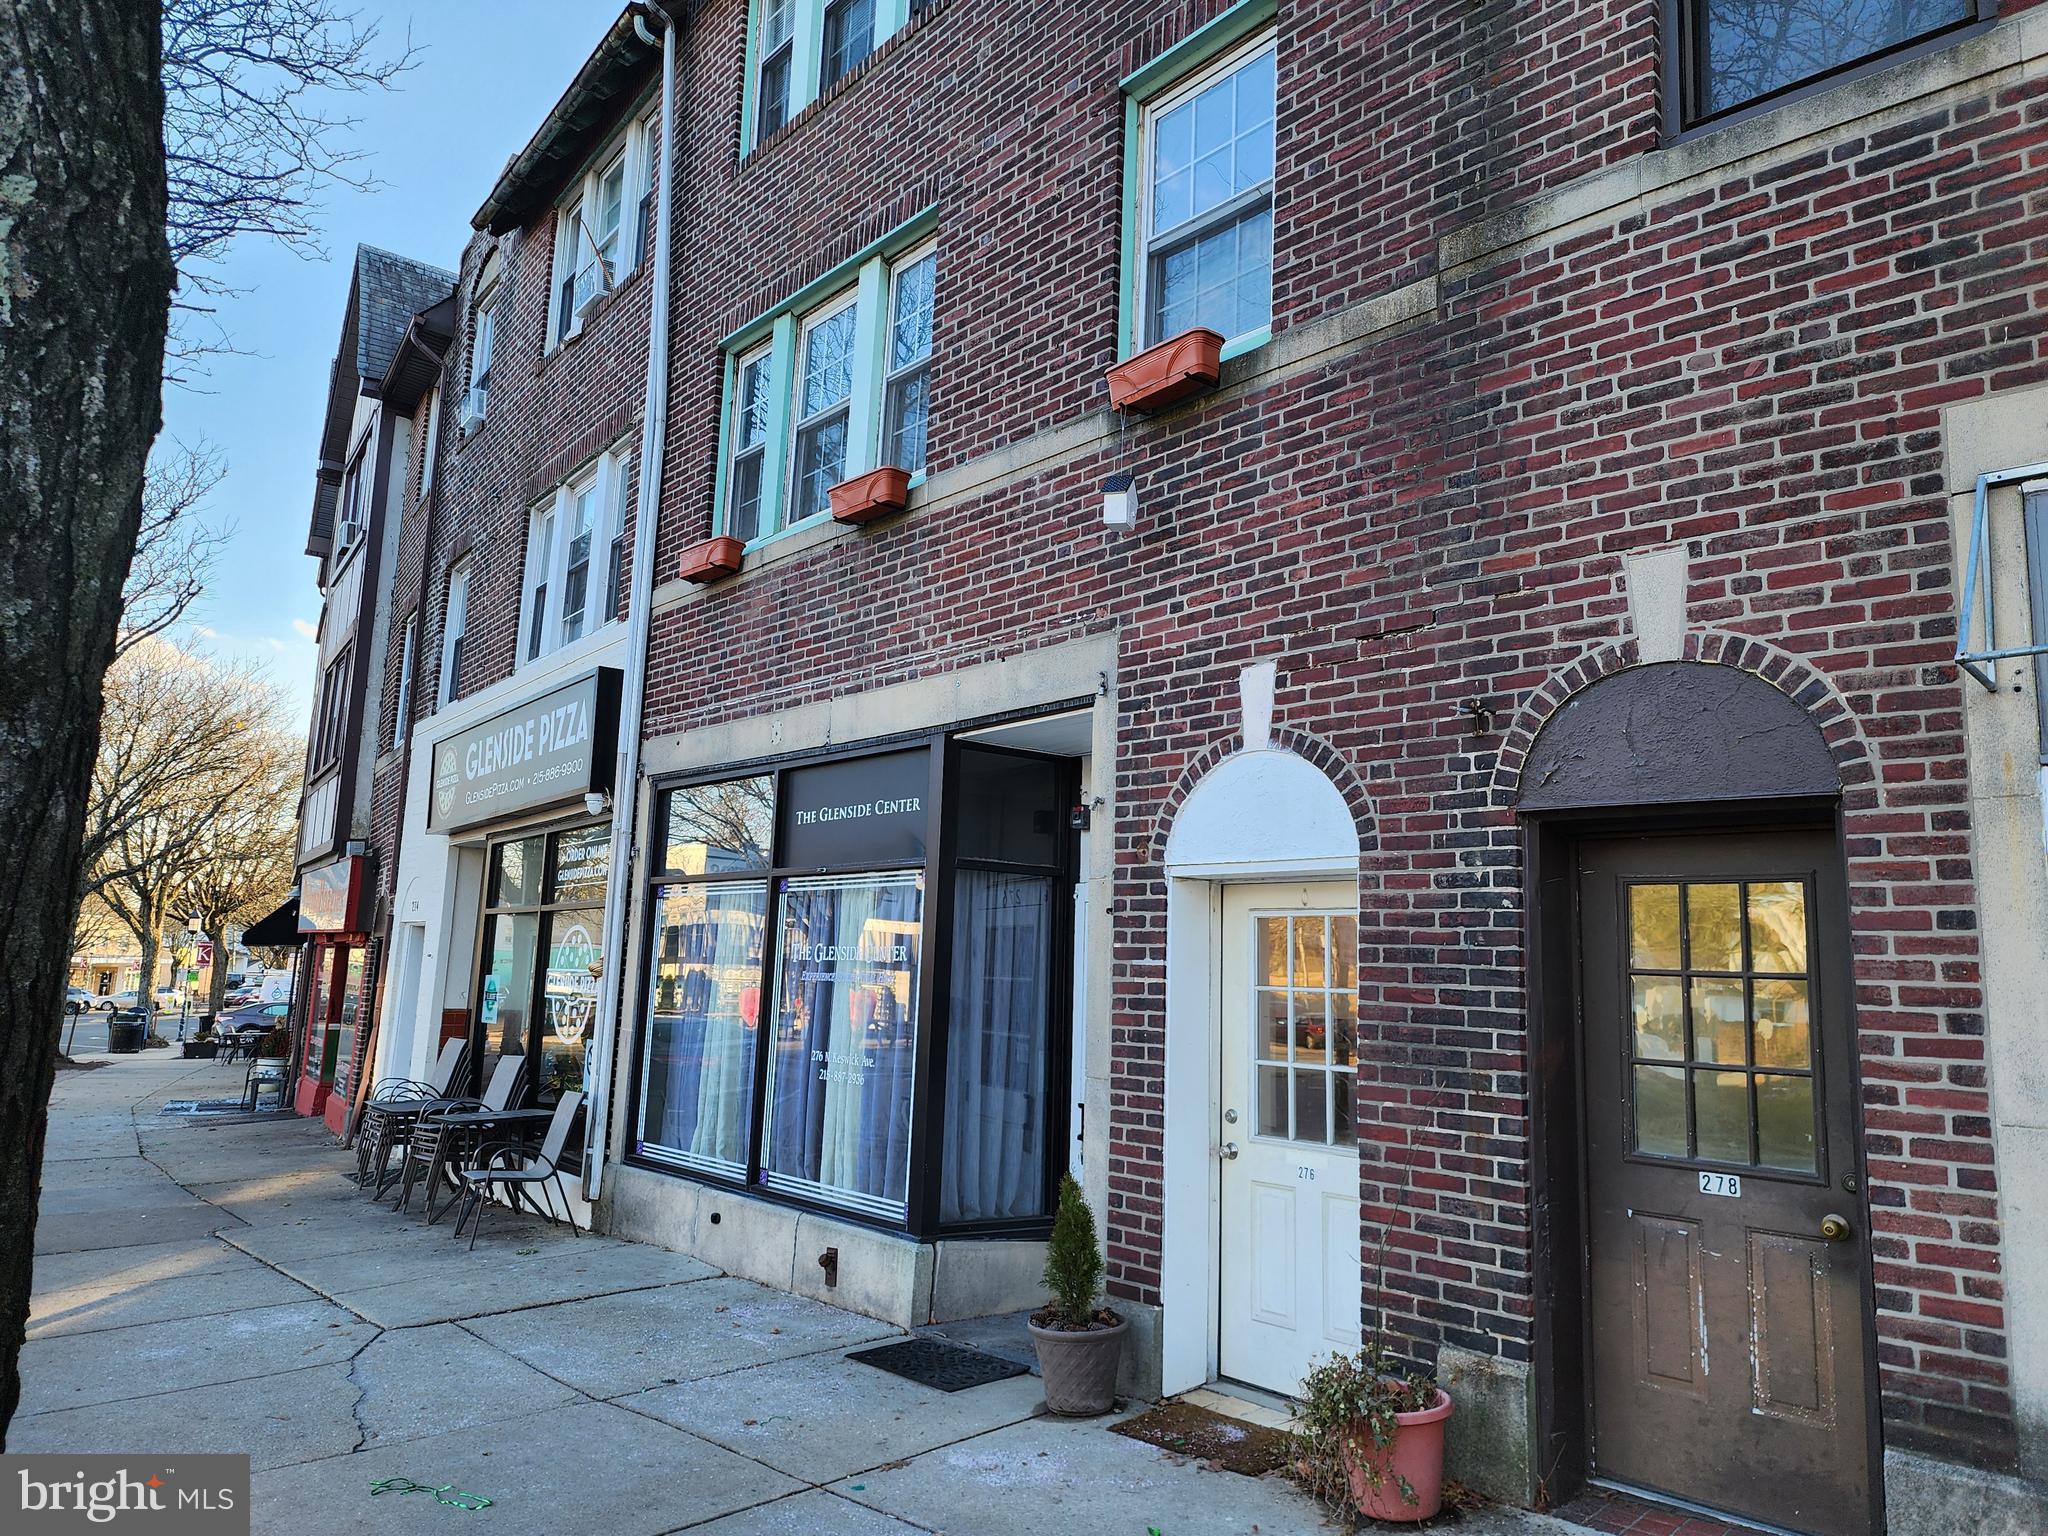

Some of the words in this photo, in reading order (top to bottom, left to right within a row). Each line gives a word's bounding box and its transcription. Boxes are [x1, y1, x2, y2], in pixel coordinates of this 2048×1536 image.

[465, 719, 535, 781] GLENSIDE
[538, 698, 588, 756] PIZZA
[532, 758, 584, 785] 215-886-9900
[796, 811, 817, 825] THE
[819, 803, 872, 822] GLENSIDE
[875, 798, 921, 815] CENTER
[566, 847, 586, 862] ORDER
[197, 946, 212, 961] K
[791, 943, 813, 963] THE
[811, 1050, 824, 1062] 276
[1298, 1166, 1315, 1181] 276
[1702, 1174, 1738, 1195] 278
